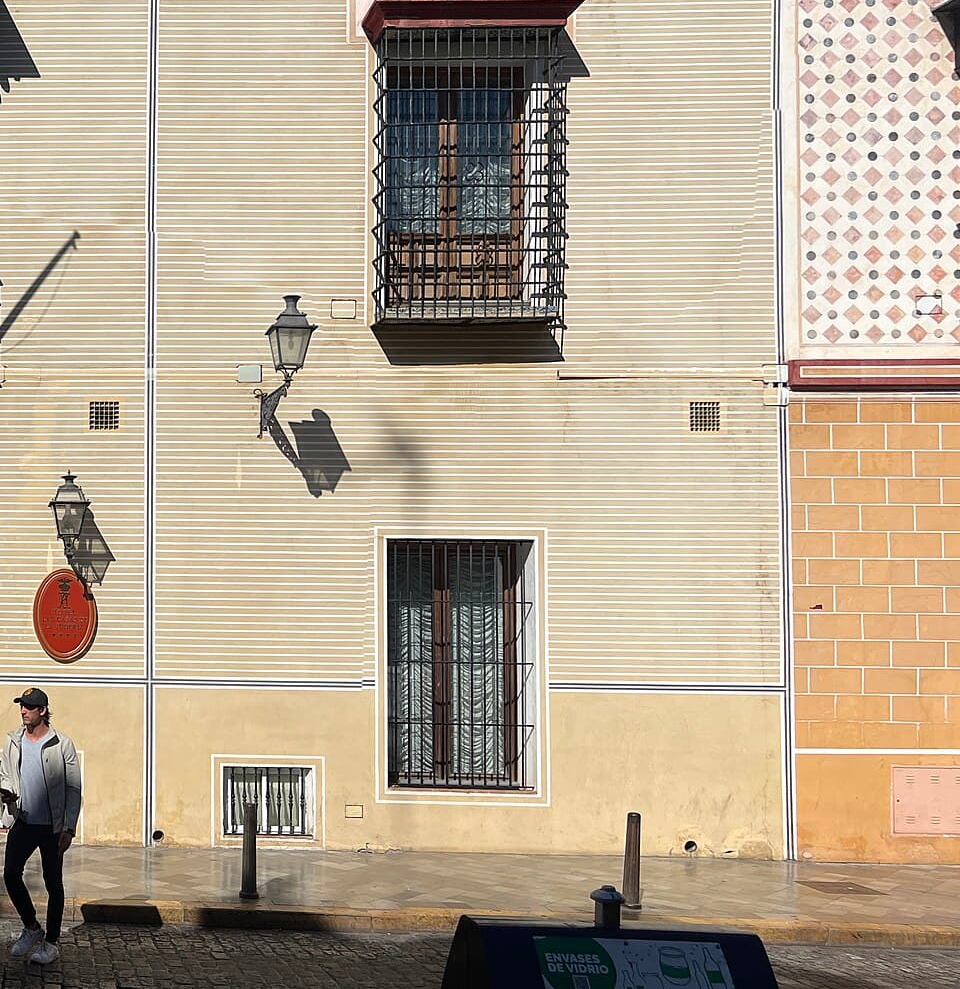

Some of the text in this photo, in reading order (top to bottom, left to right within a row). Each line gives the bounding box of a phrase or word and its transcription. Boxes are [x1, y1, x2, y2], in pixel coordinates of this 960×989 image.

[544, 952, 601, 964] ENVASES
[547, 962, 609, 974] DE VIDRIO
